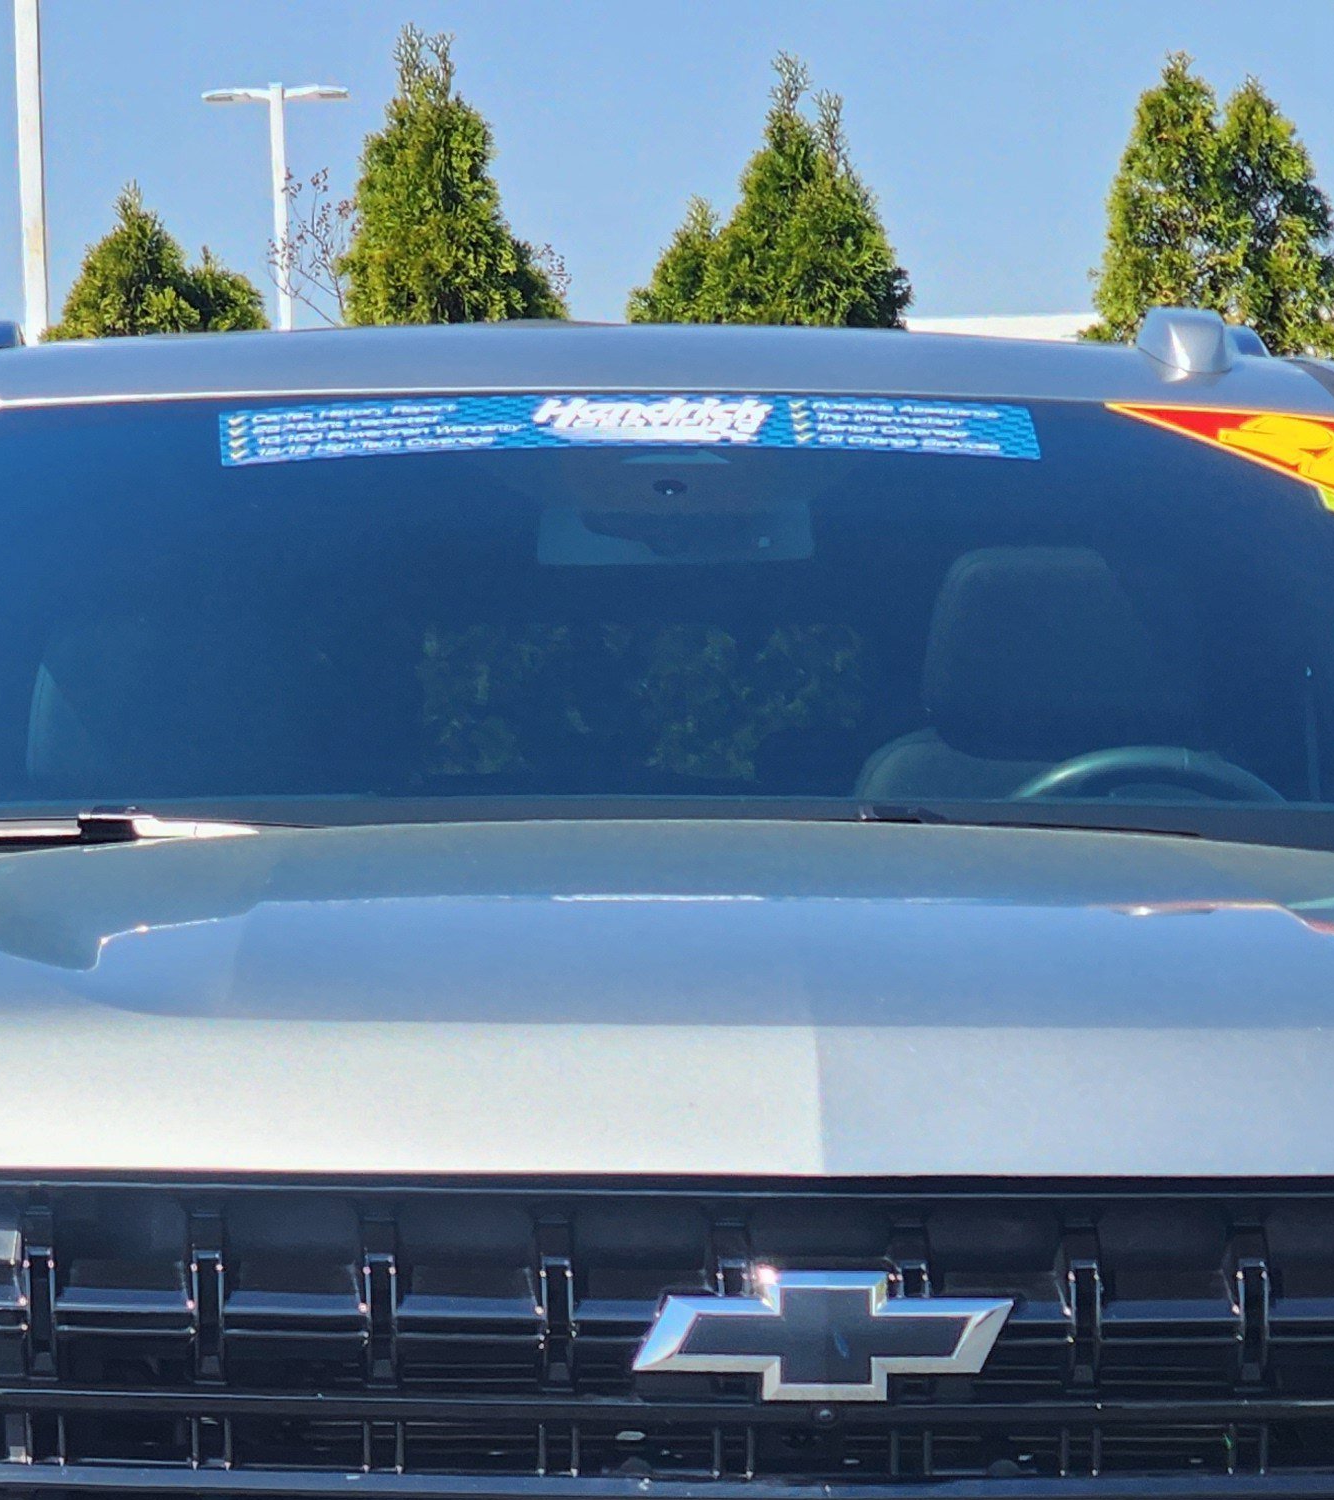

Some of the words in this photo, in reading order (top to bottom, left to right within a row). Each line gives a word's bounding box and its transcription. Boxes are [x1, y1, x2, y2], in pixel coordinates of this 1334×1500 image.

[391, 404, 458, 416] Report
[533, 398, 772, 428] Hendrick
[898, 405, 1000, 418] Assistance
[435, 423, 527, 435] Warranty
[405, 436, 495, 448] Coverage
